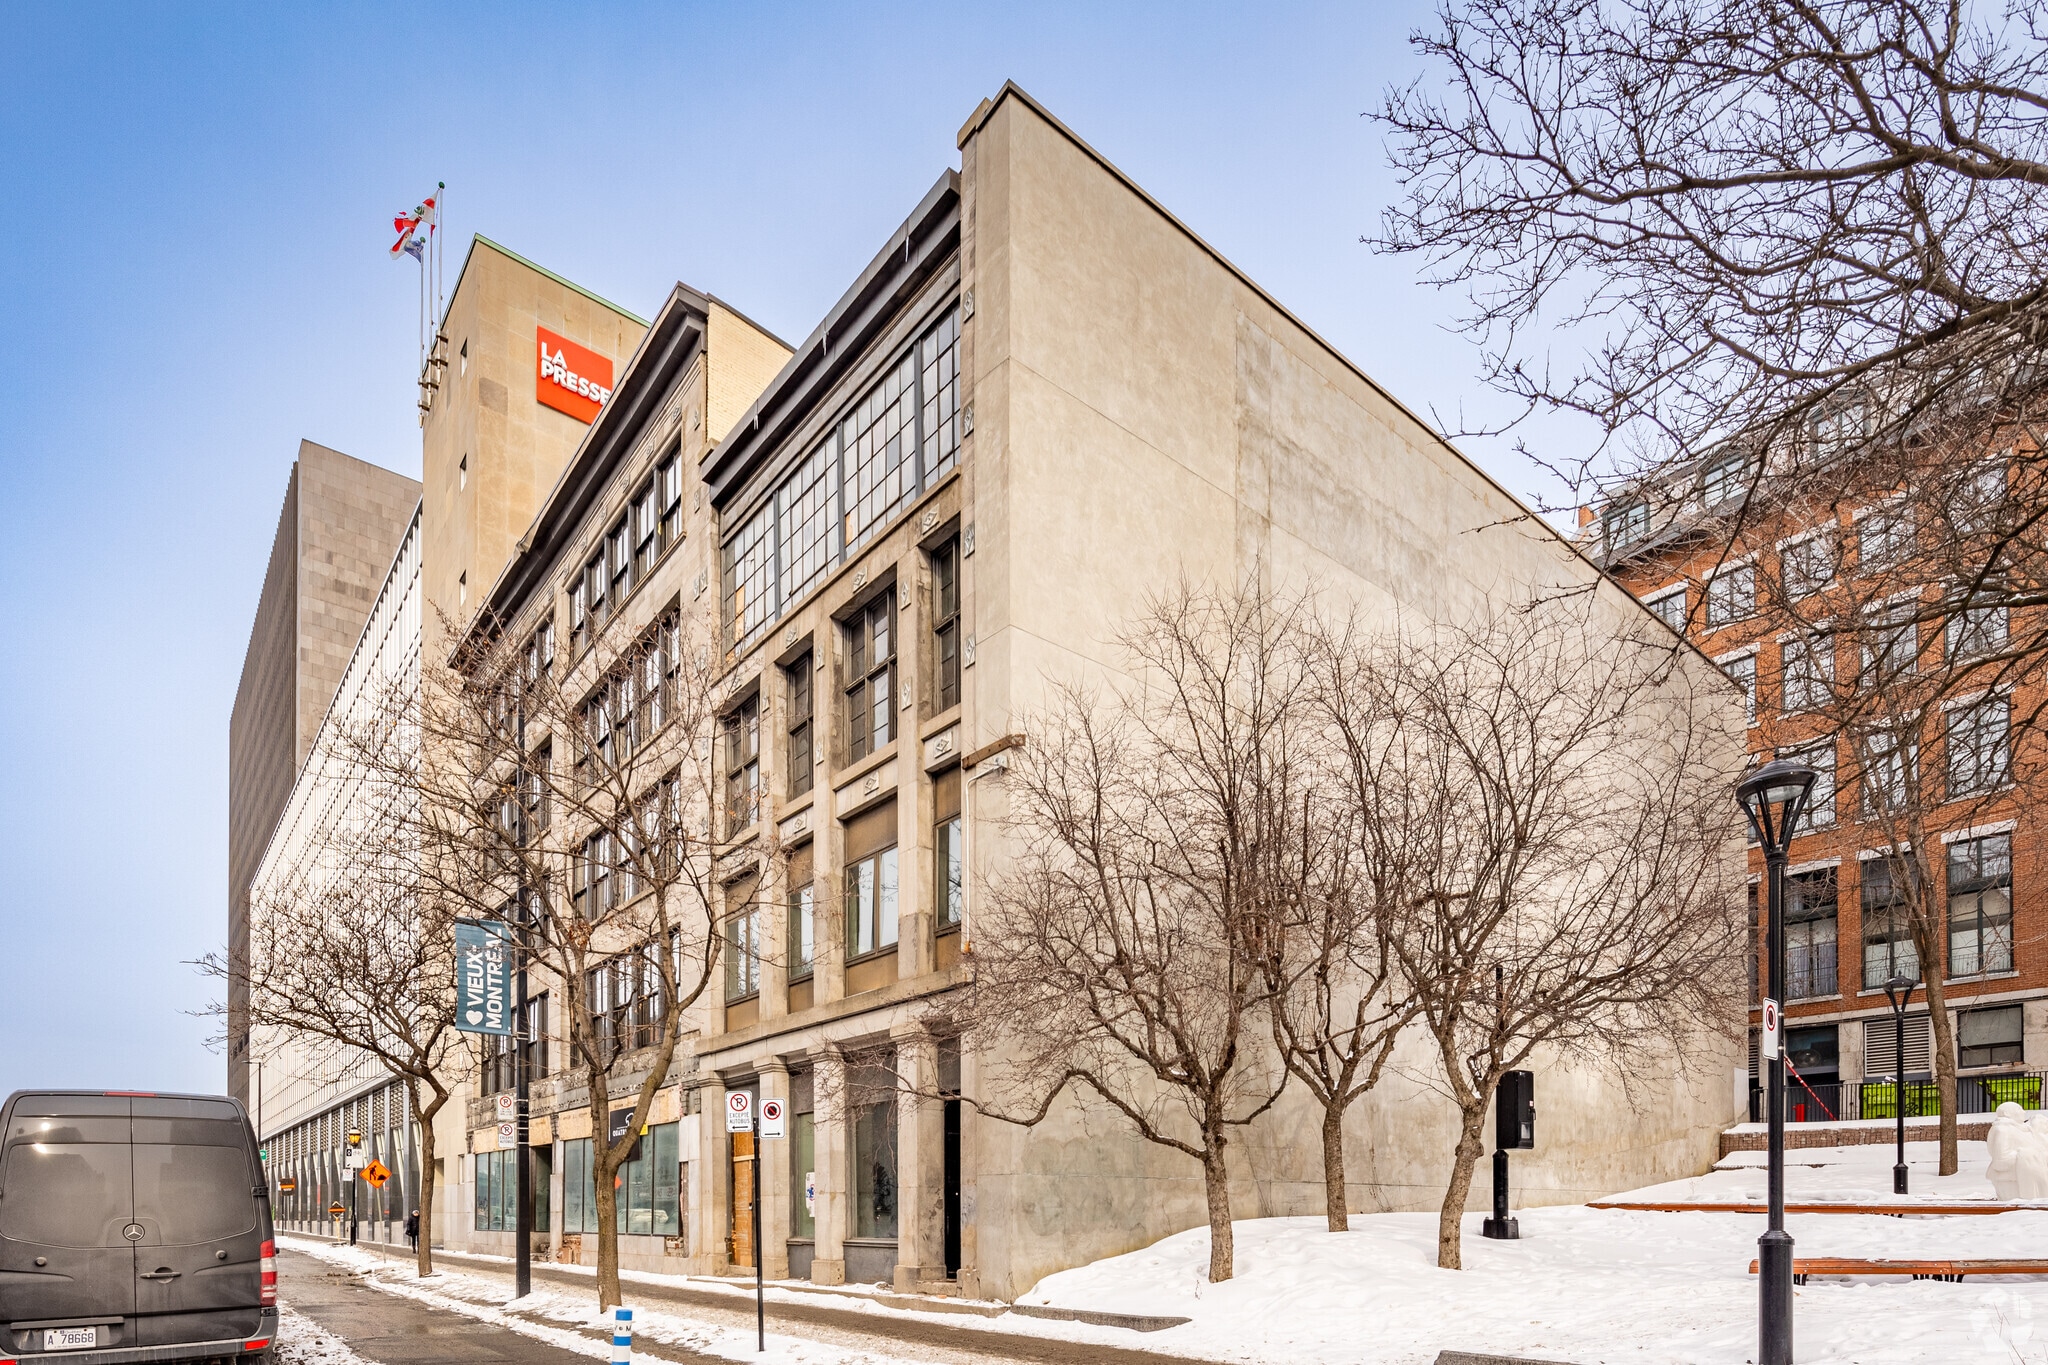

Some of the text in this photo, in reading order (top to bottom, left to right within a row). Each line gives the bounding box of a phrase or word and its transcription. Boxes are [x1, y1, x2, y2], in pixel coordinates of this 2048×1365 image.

[541, 341, 567, 369] LA
[541, 360, 612, 406] PRESSE
[485, 928, 503, 1029] MONTRÉAL
[47, 1332, 94, 1345] A 78668
